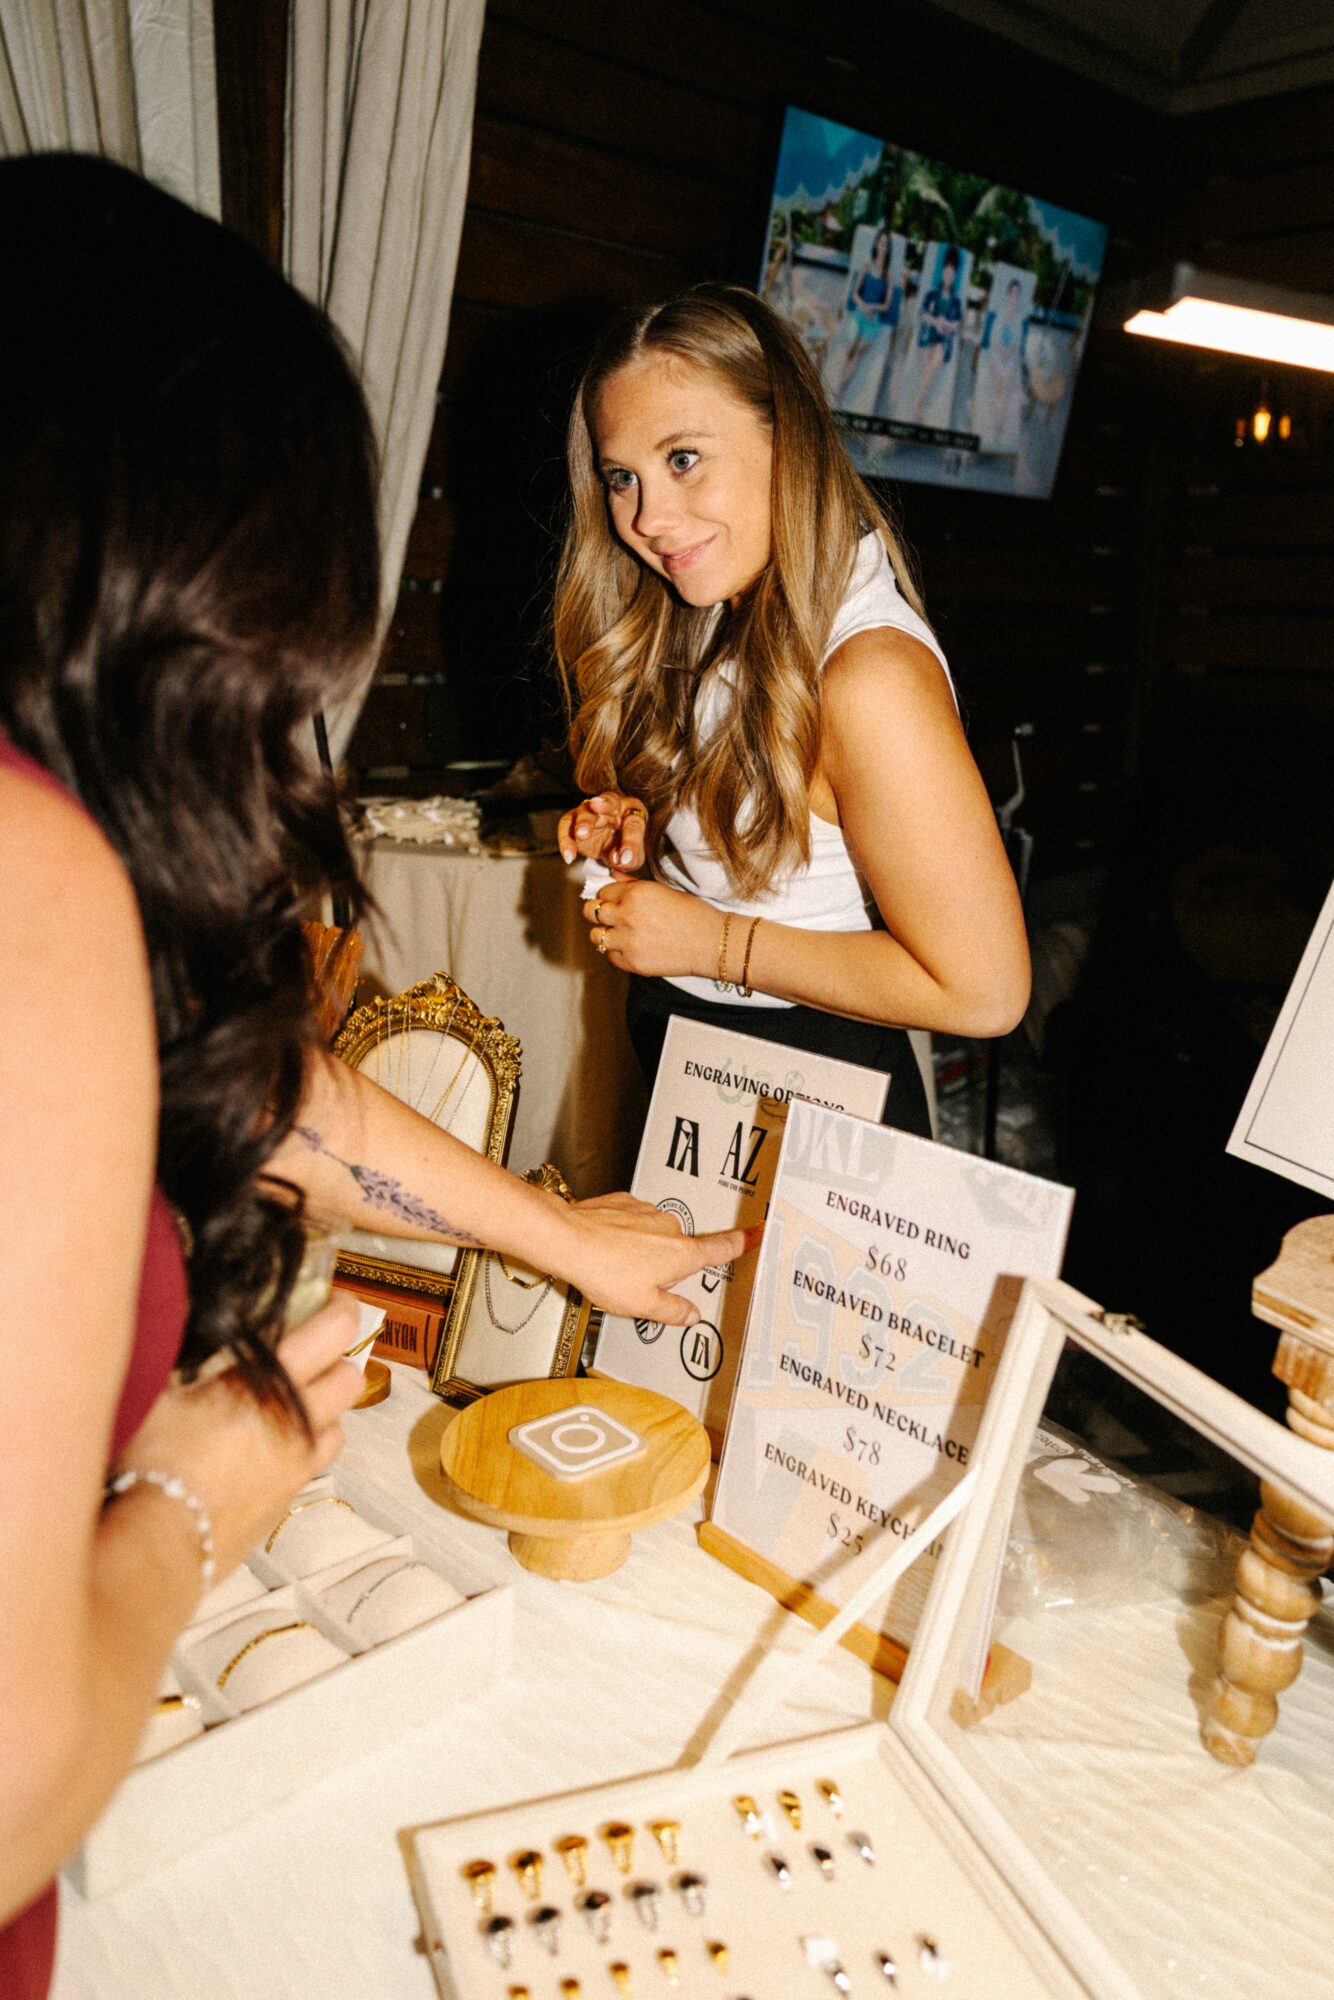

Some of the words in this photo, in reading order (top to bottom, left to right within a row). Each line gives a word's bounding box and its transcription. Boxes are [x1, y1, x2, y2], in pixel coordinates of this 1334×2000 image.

[684, 1060, 770, 1098] ENGRAVING
[719, 1120, 769, 1187] AZ
[826, 1190, 919, 1240] ENGRAVED
[925, 1228, 971, 1260] RING
[865, 1243, 907, 1282] $68
[793, 1270, 883, 1322] ENGRAVED
[888, 1307, 985, 1368] BRACELET
[859, 1333, 896, 1371] $72
[779, 1354, 868, 1411] ENGRAVED
[873, 1403, 969, 1466] NECKLACE
[843, 1425, 882, 1466] $78
[764, 1443, 852, 1505] ENGRAVED
[857, 1496, 942, 1560] KEYCHI
[826, 1512, 864, 1556] $25
